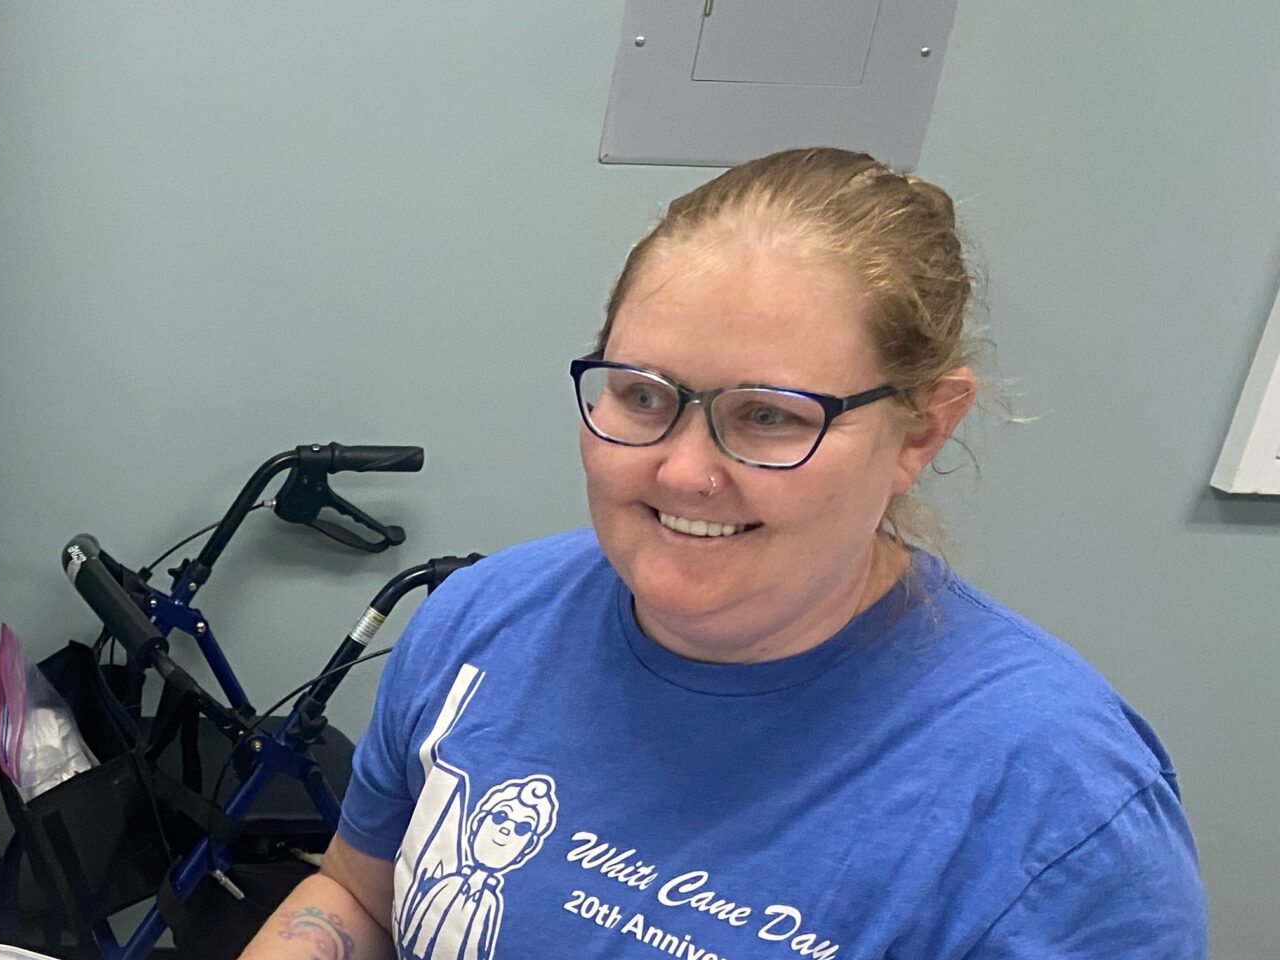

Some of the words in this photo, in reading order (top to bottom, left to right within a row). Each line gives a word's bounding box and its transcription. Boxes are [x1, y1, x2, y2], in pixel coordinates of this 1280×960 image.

[563, 890, 622, 929] 20th
[566, 831, 658, 891] White
[657, 870, 752, 926] Cane
